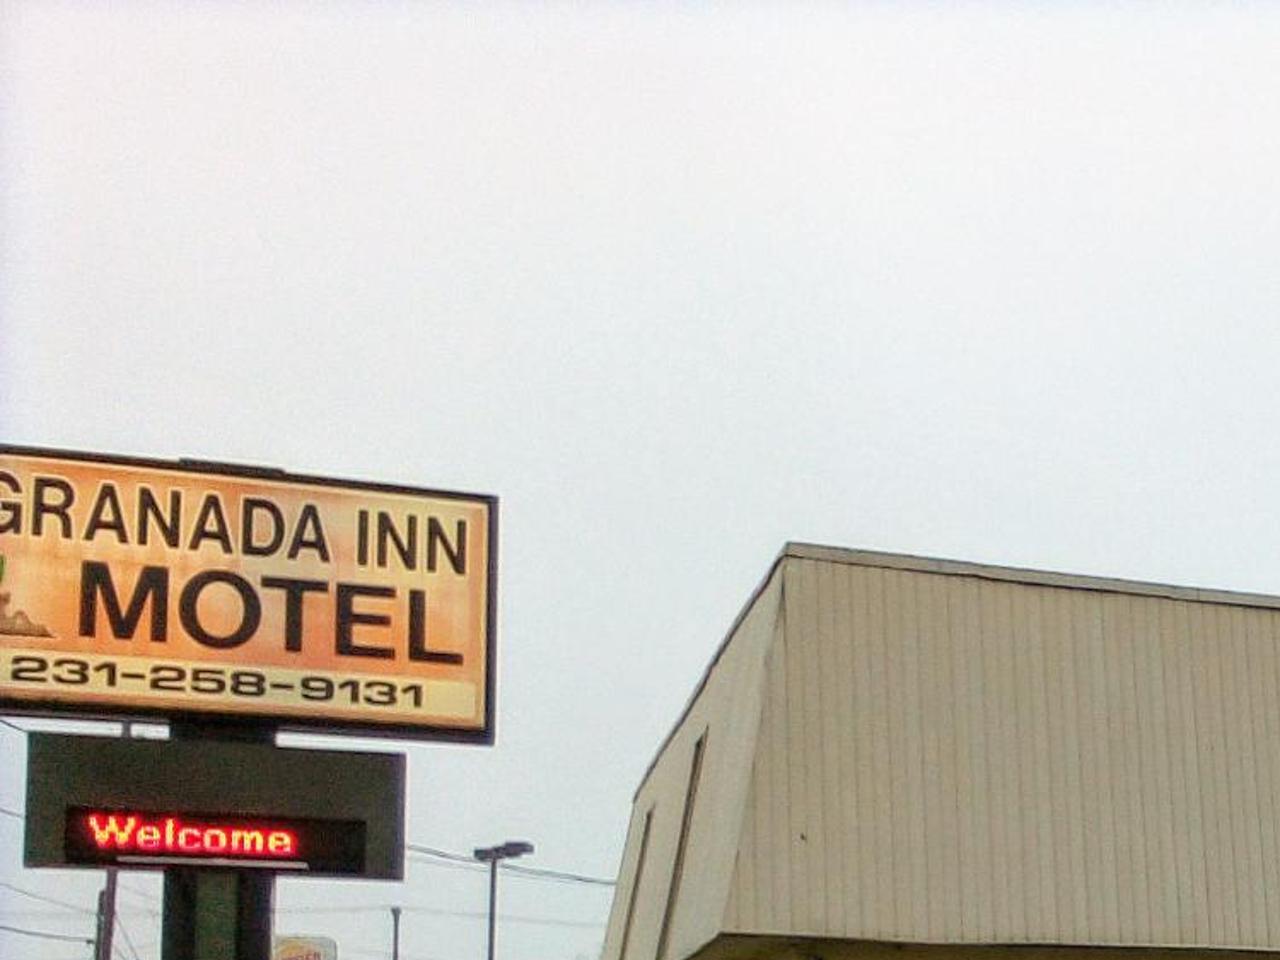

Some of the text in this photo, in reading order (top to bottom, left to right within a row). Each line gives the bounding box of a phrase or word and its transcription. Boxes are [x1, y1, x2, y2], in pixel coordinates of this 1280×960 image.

[0, 470, 467, 575] GRANADA INN
[78, 559, 464, 666] MOTEL
[10, 655, 424, 708] 231-258-9131
[88, 814, 293, 855] Welcome
